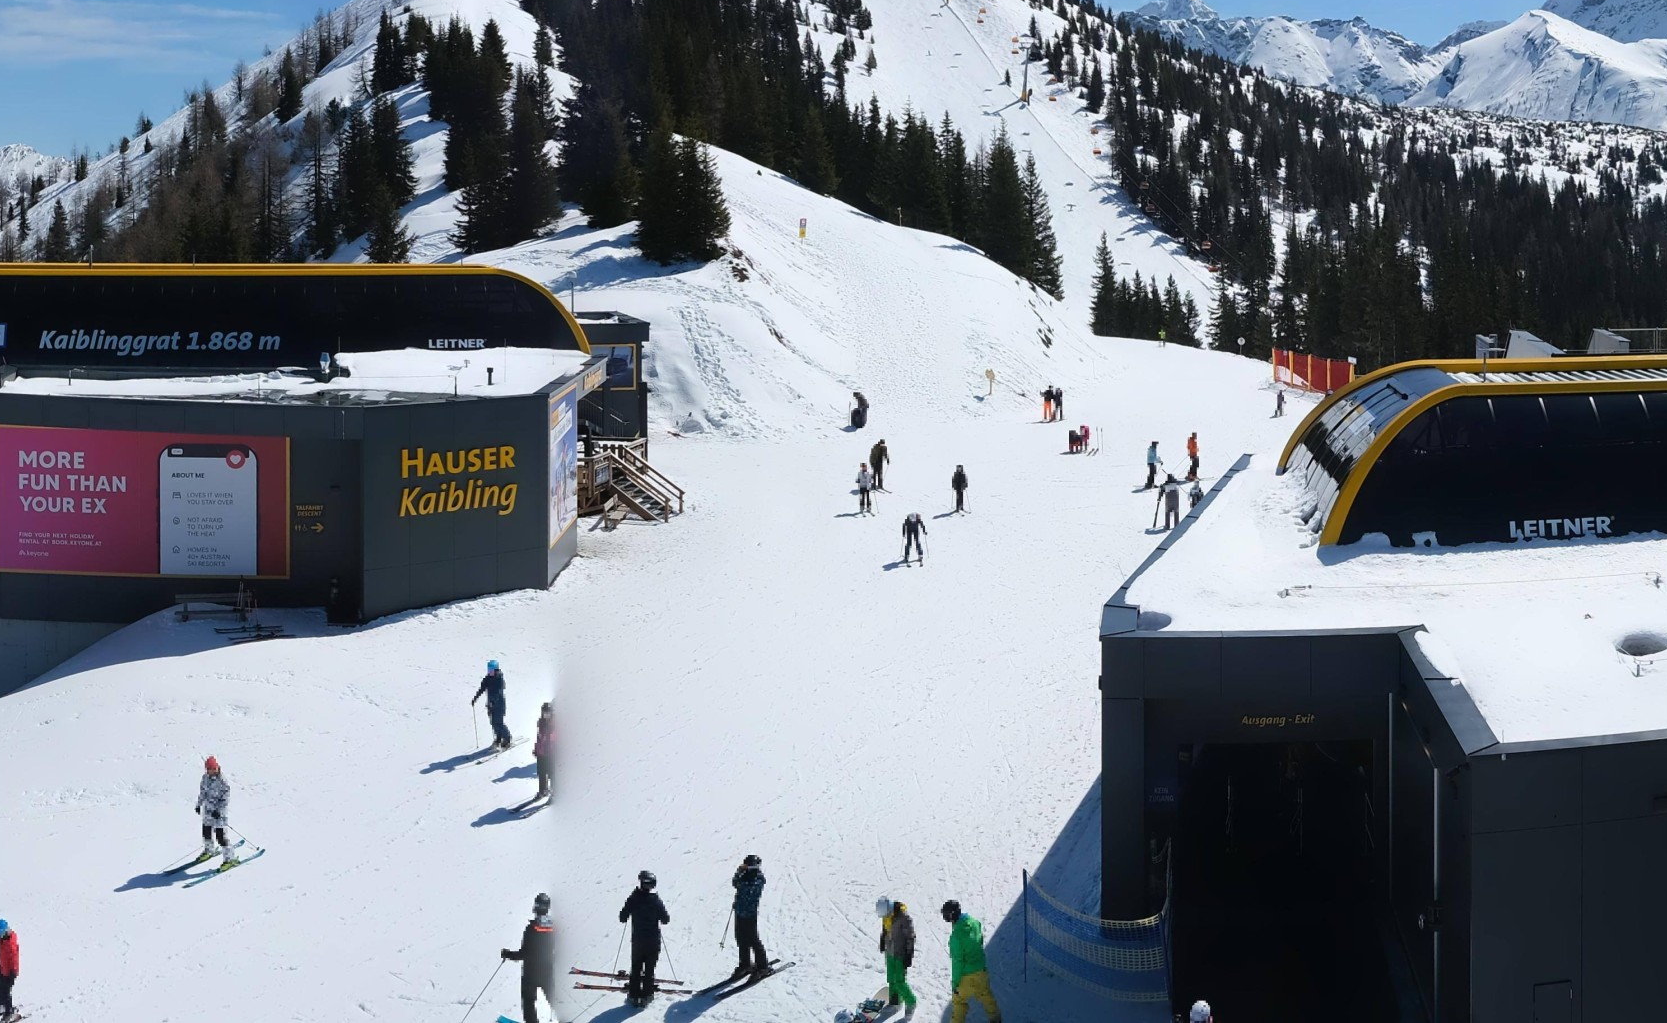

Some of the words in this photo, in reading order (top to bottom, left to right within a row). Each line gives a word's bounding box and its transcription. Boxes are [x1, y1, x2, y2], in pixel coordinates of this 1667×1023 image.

[39, 329, 181, 357] Kaiblinggrat
[186, 330, 253, 350] 1.868
[259, 334, 281, 350] m
[428, 338, 485, 349] LEITNER
[18, 450, 85, 469] MORE
[401, 445, 516, 478] HAUSER
[18, 474, 60, 490] FUN
[67, 475, 127, 492] THAN
[20, 496, 75, 513] YOUR
[81, 497, 107, 513] EX
[399, 479, 518, 517] Kaibling
[1509, 515, 1612, 539] LEITNER
[1241, 715, 1286, 727] Ausgang
[1294, 713, 1316, 724] Exit
